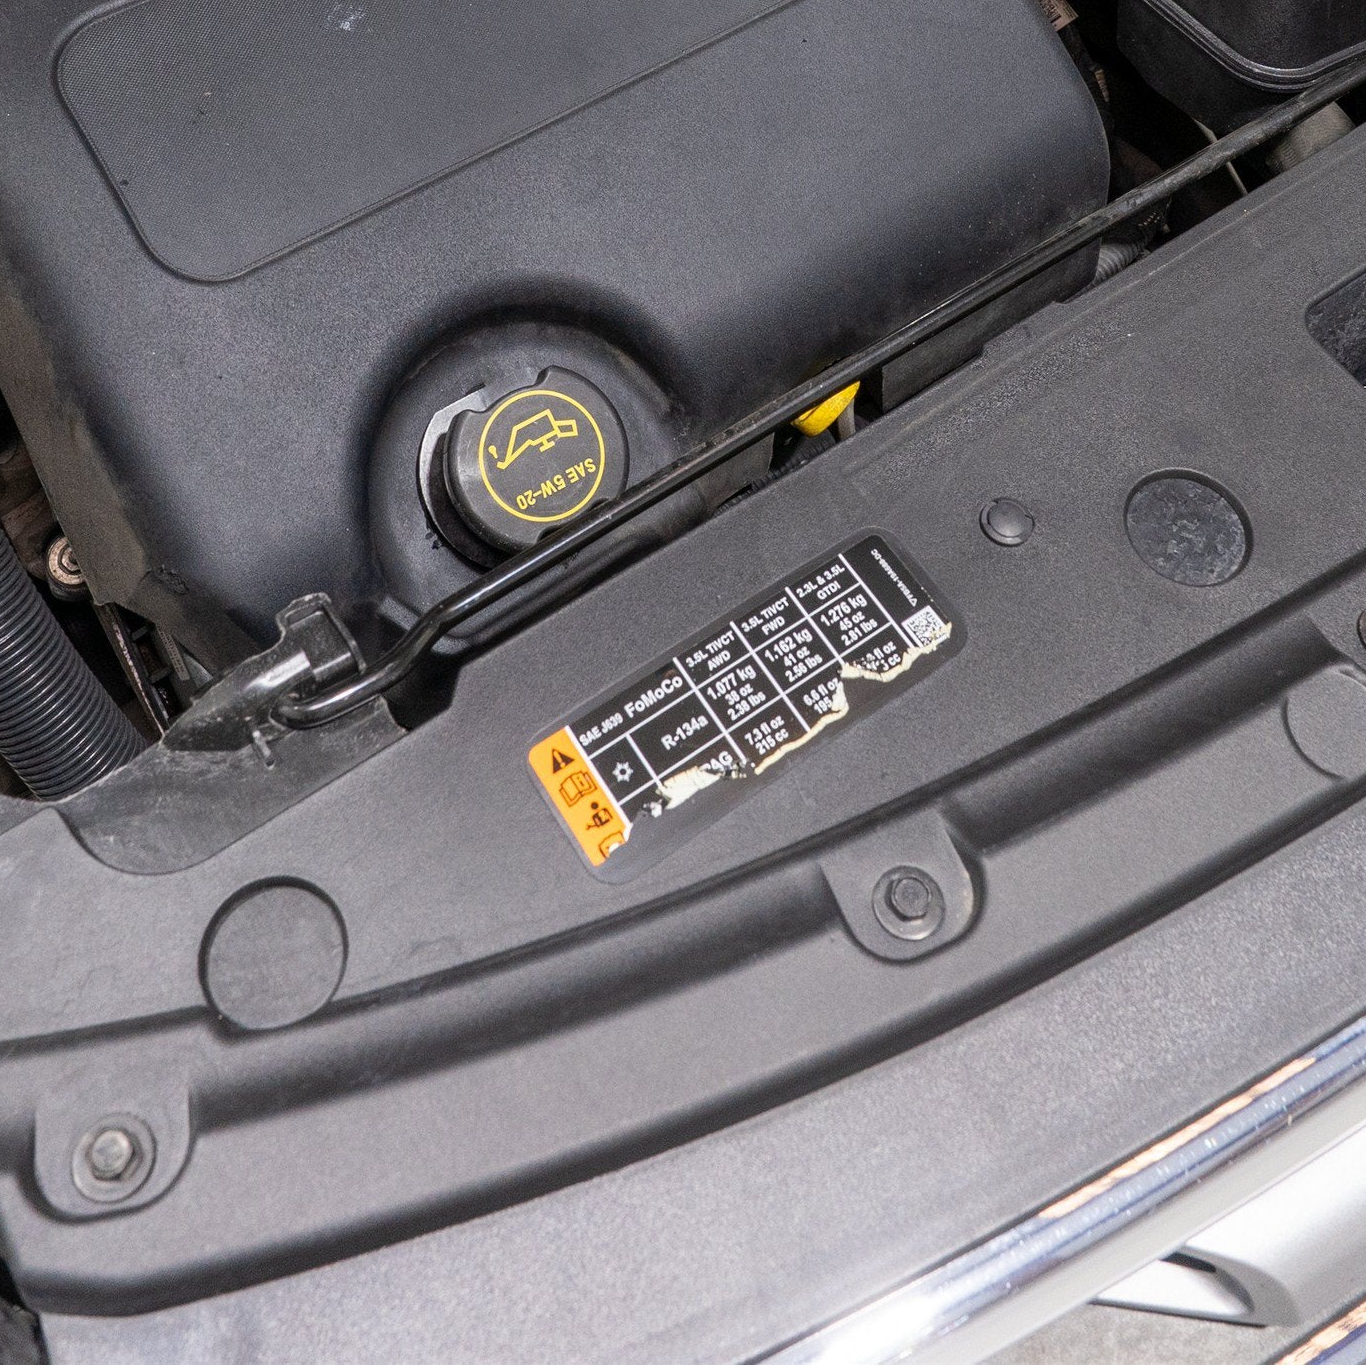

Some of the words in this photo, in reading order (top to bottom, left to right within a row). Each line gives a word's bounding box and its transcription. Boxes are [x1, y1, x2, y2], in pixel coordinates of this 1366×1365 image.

[565, 458, 596, 484] SAE
[517, 474, 566, 510] 5W-20
[796, 580, 818, 598] 2.3L
[816, 575, 826, 586] &
[823, 564, 846, 580] 3.5L
[817, 580, 842, 600] GTDI
[820, 601, 851, 627] 1.276
[847, 594, 868, 609] kg
[839, 617, 853, 631] 45
[852, 611, 866, 624] oz
[741, 615, 764, 633] 3.5L
[761, 616, 785, 635] FWD
[841, 627, 863, 646] 2.81
[860, 618, 878, 633] lbs
[765, 636, 797, 662] 1.162
[793, 628, 813, 644] kg
[784, 653, 797, 667] 41
[796, 646, 810, 659] oz
[882, 641, 897, 654] oz
[686, 650, 708, 668] 3.5L
[707, 650, 731, 671] AWD
[785, 662, 808, 682] 2.56
[805, 654, 823, 669] lbs
[888, 653, 902, 666] cc
[707, 672, 737, 700] 1.077
[736, 665, 757, 681] kg
[725, 690, 740, 705] 38
[739, 684, 754, 697] oz
[803, 689, 820, 706] 6.6
[818, 684, 829, 696] fl
[827, 677, 840, 691] oz
[579, 726, 603, 746] SAE
[601, 713, 623, 733] J639
[624, 676, 683, 718] FoMoCo
[727, 700, 750, 721] 2.38
[747, 691, 766, 707] lbs
[814, 695, 834, 715] 195
[661, 715, 709, 750] R-134a
[745, 728, 763, 745] 7.3
[760, 722, 772, 734] fl
[770, 715, 785, 729] oz
[756, 734, 777, 755] 215
[775, 729, 789, 742] cc
